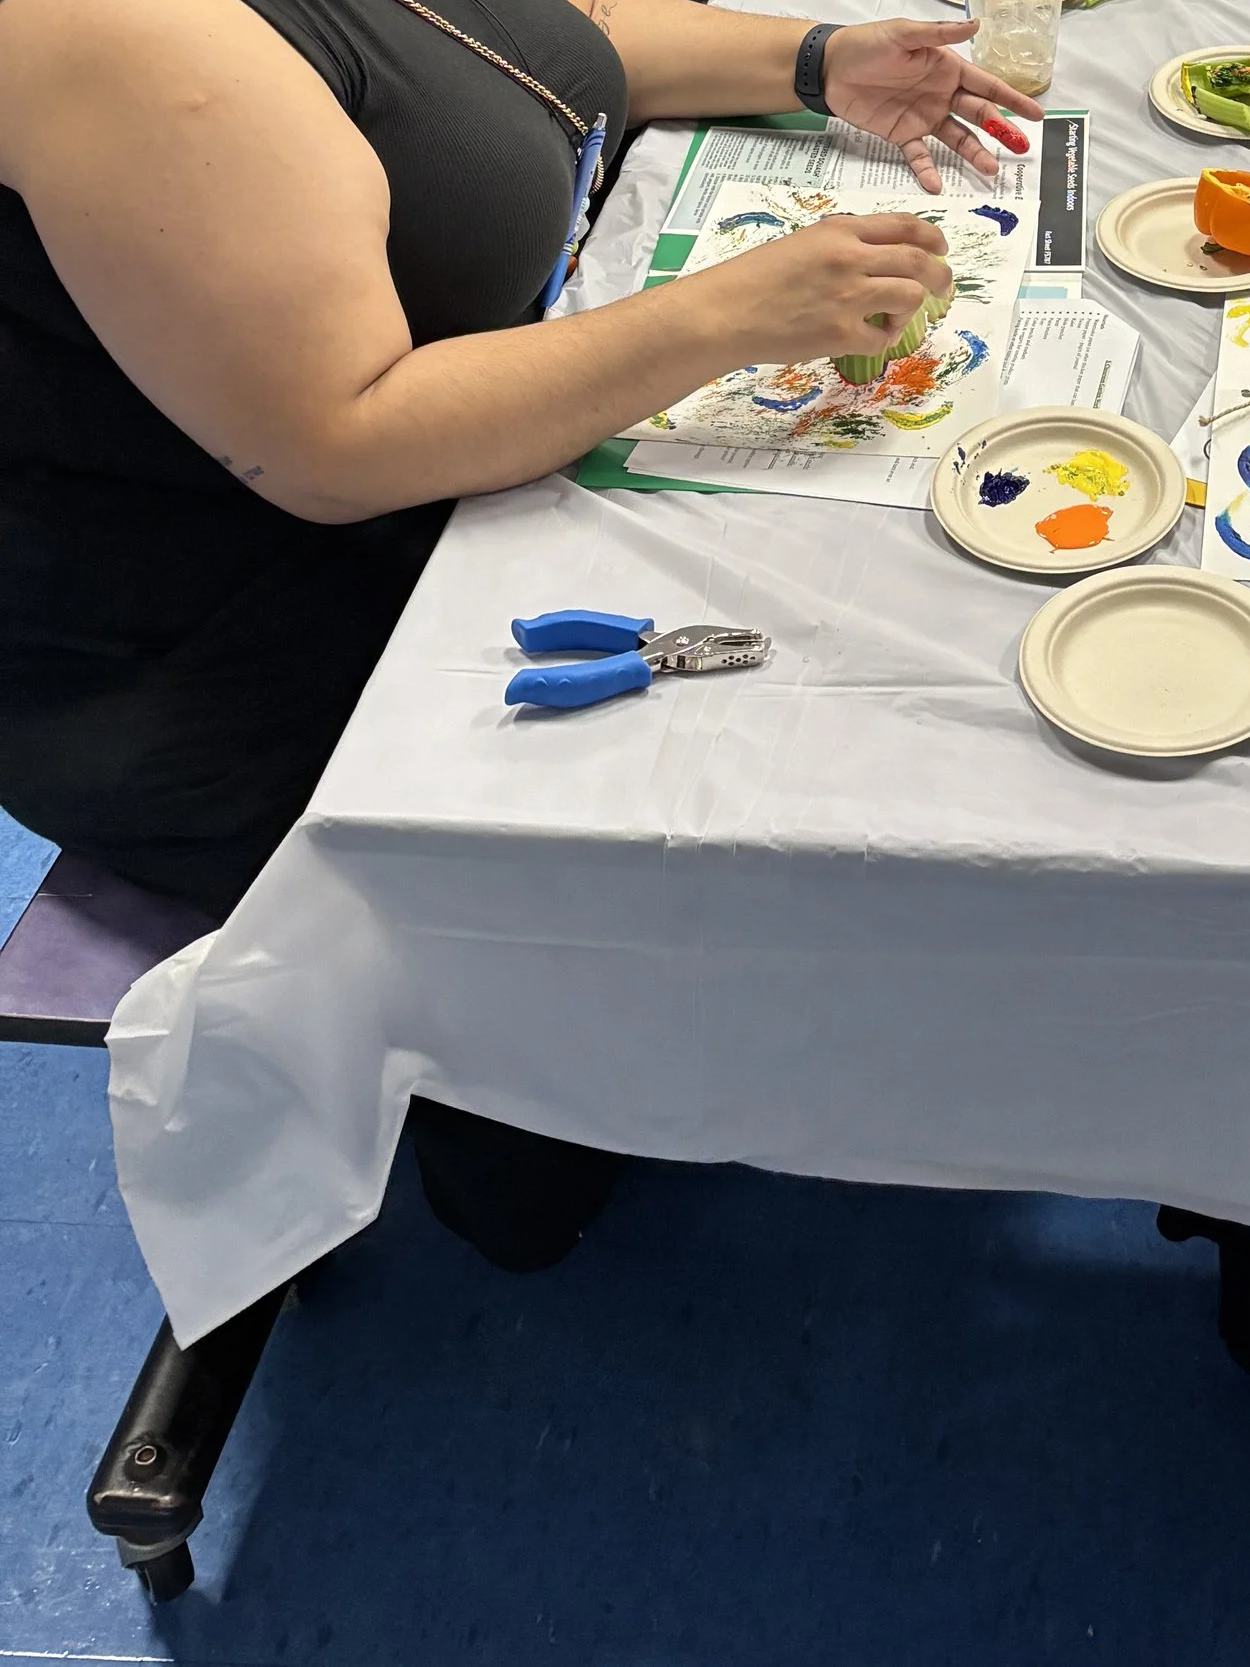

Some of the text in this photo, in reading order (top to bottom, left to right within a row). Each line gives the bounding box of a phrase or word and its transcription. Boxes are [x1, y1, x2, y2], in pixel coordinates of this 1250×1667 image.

[1014, 164, 1026, 195] Cooperative
[1065, 123, 1079, 211] Starting Vegetable Seeds Indoors
[1044, 238, 1053, 251] Sheet
